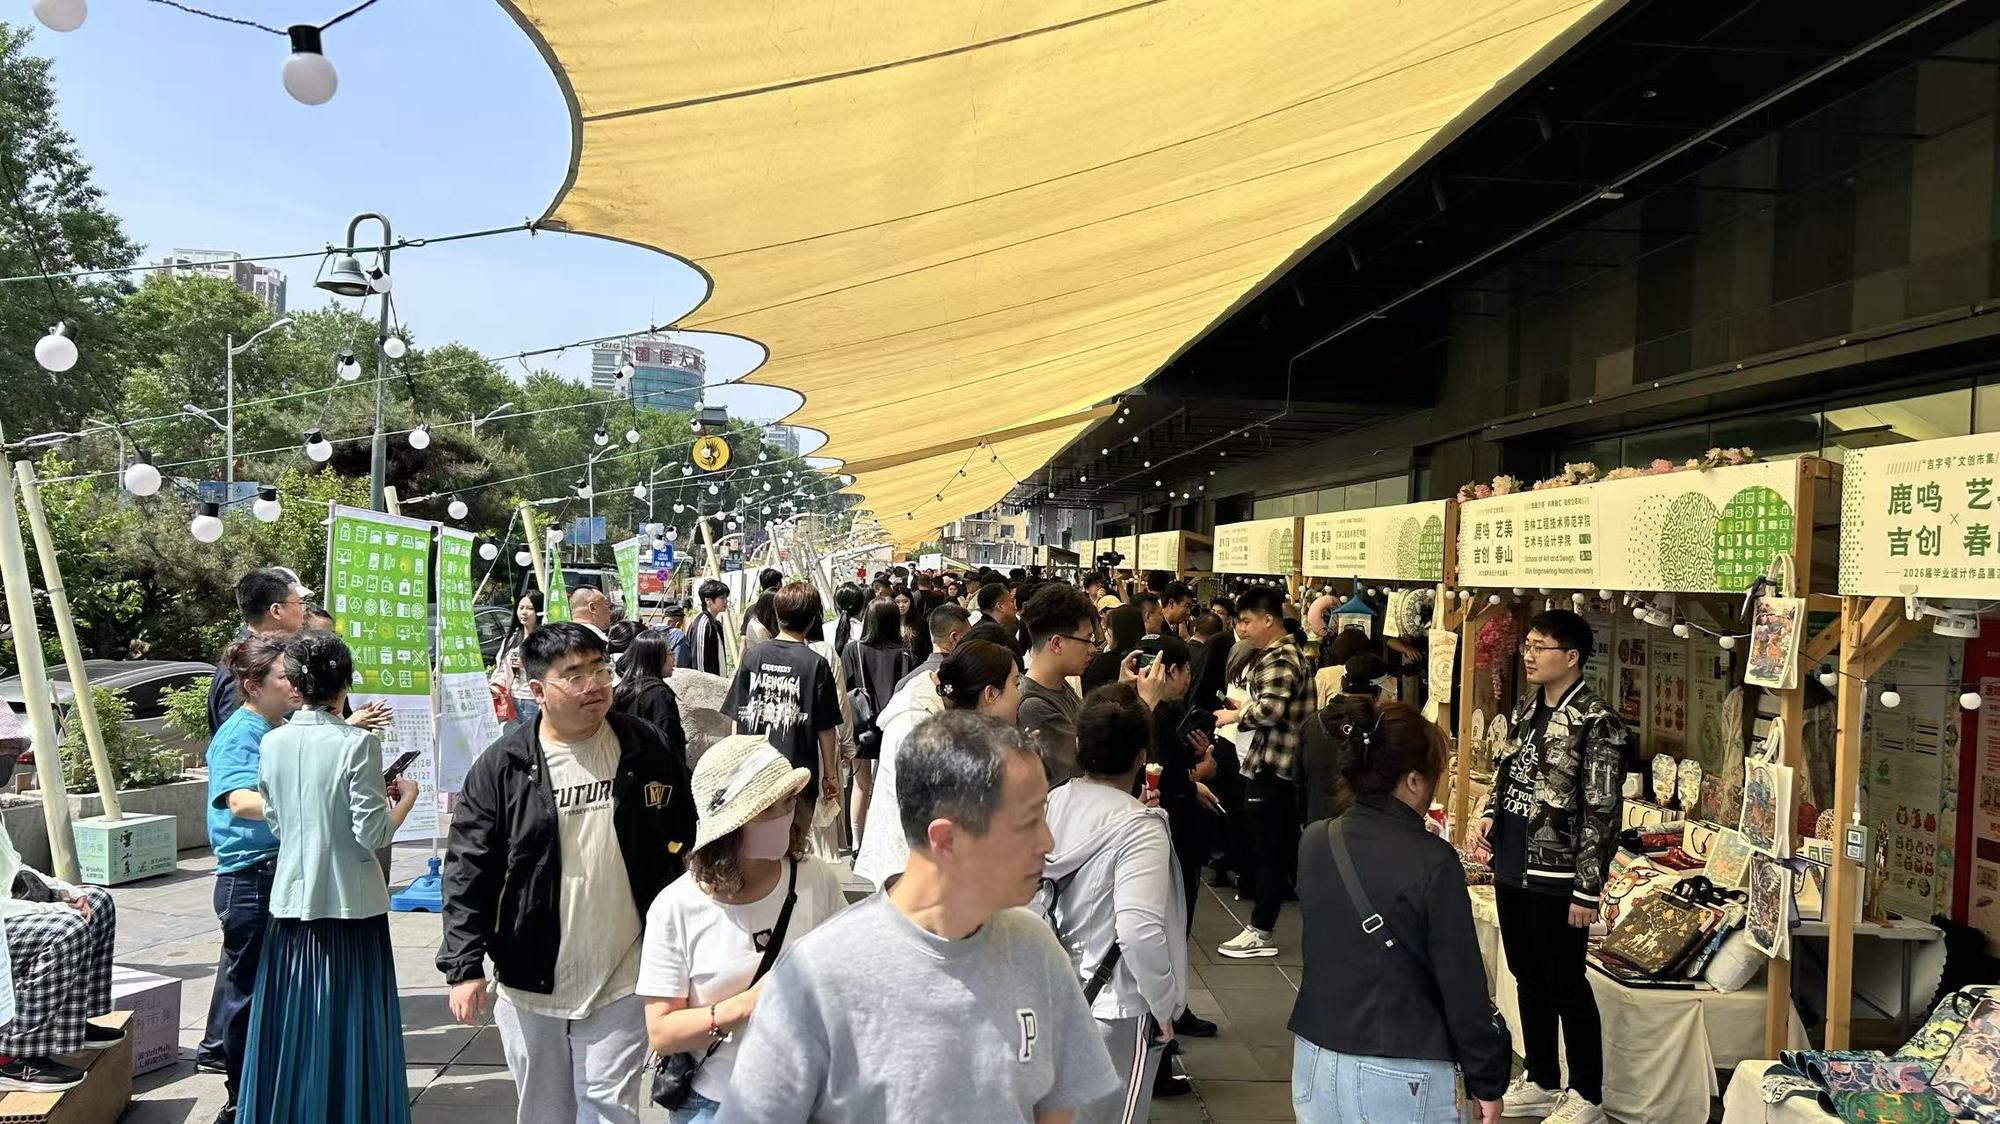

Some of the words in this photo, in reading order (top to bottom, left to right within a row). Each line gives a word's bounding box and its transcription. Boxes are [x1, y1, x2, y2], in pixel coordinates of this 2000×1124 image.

[1887, 481, 1943, 515] 鹿鸣
[1966, 477, 2000, 511] 艺
[1495, 519, 1513, 539] 艺美
[1524, 515, 1591, 532] 吉林工程技术师范学院
[1524, 534, 1572, 548] 艺术与设计学院
[1887, 524, 1941, 557] 吉创
[1963, 523, 2000, 557] 春
[1474, 546, 1490, 564] 吉创
[1495, 545, 1513, 563] 春山
[1903, 567, 2000, 580] 2026届毕业设计作品展
[1016, 1008, 1038, 1063] P
[1407, 1081, 1421, 1097] V
